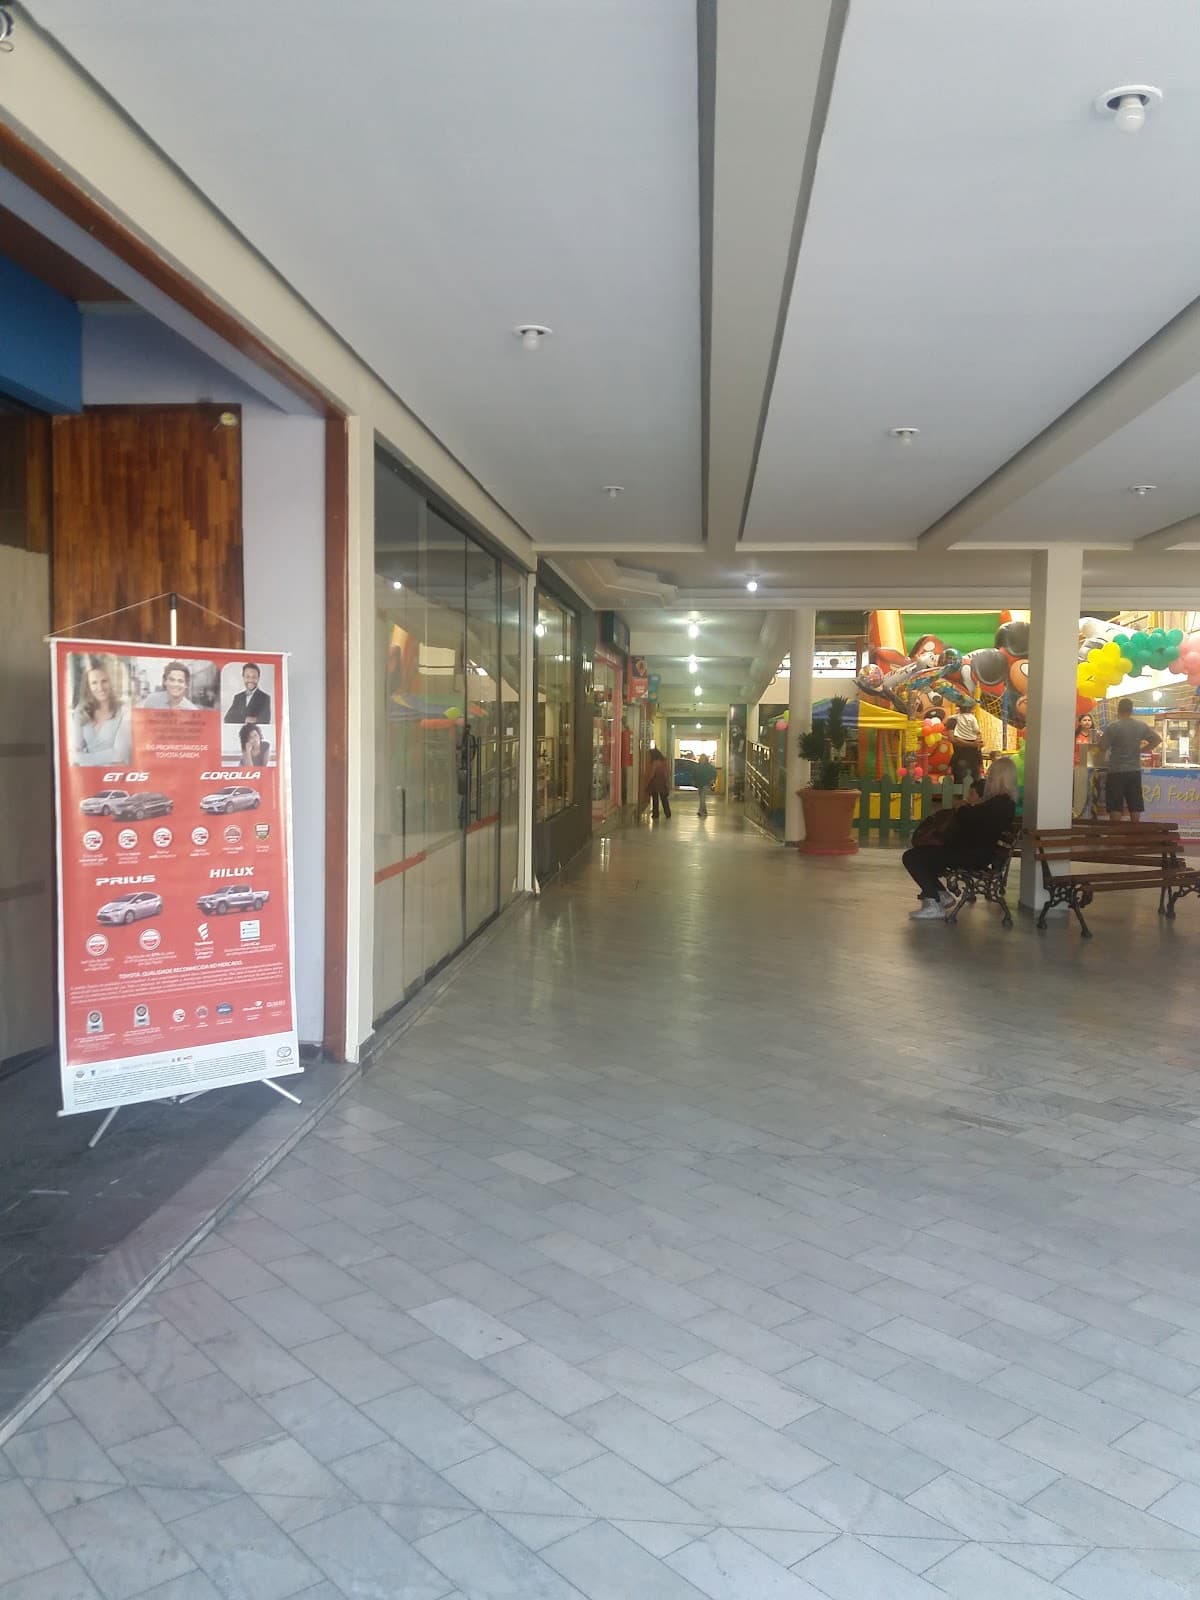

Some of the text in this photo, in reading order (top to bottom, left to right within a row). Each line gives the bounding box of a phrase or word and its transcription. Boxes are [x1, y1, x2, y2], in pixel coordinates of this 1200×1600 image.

[103, 772, 149, 782] ETOS
[200, 771, 261, 781] COROLLA
[209, 866, 255, 878] HILUX
[95, 874, 156, 887] PRIUS
